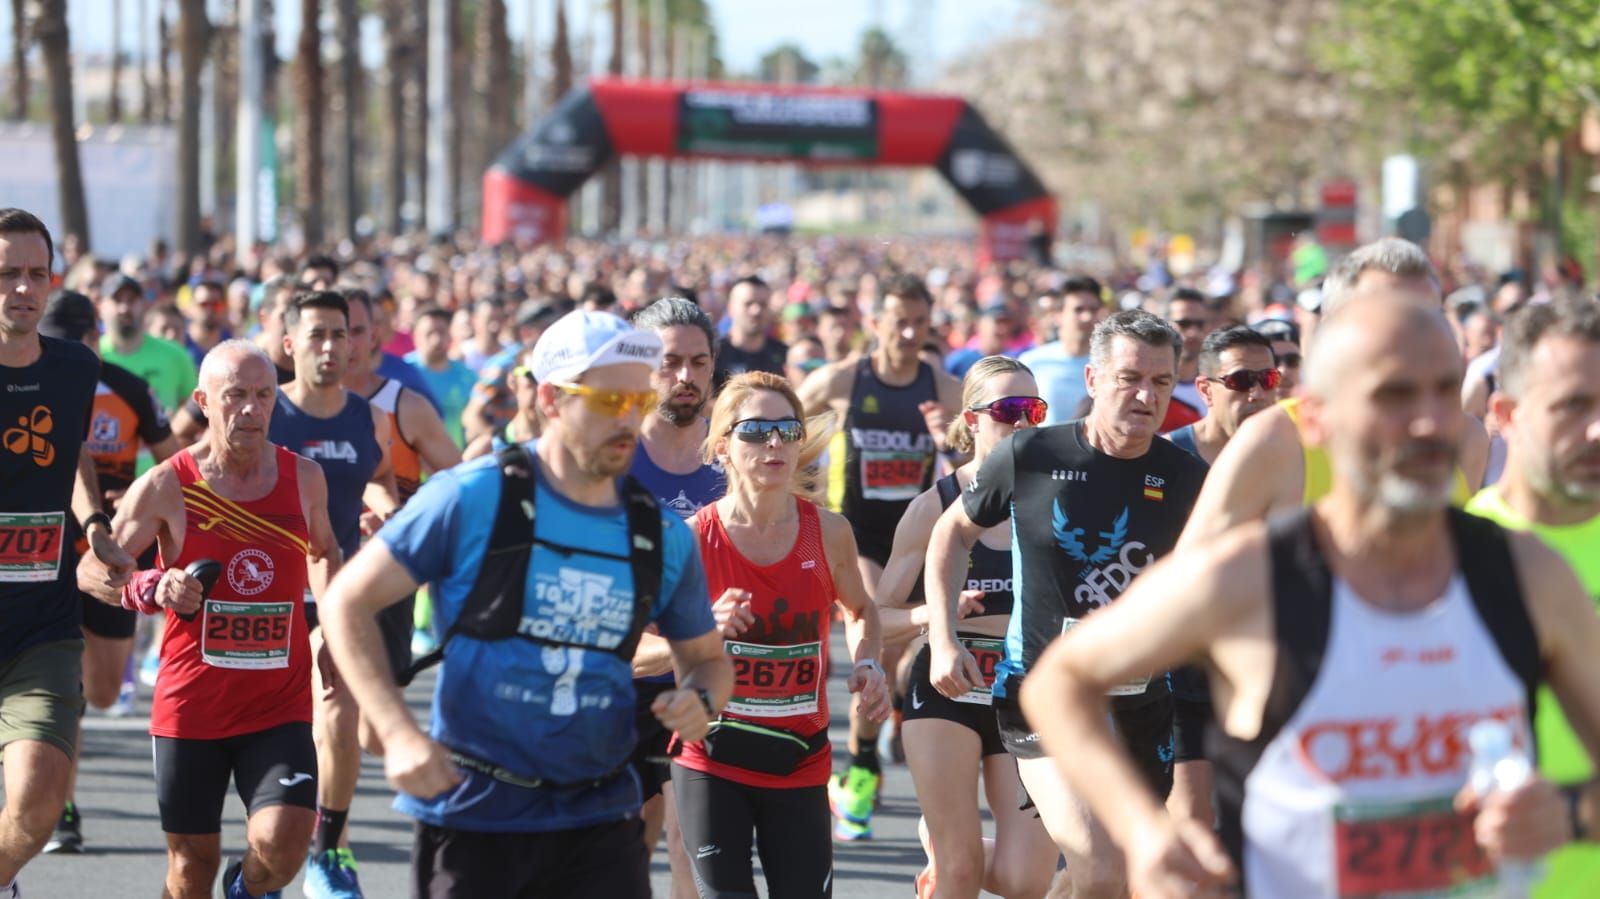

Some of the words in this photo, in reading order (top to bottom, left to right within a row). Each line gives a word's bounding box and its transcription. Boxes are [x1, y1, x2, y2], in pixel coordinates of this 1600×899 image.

[303, 440, 358, 460] FILA
[1144, 474, 1165, 487] ESP
[208, 615, 287, 642] 2865
[734, 658, 815, 688] 2678
